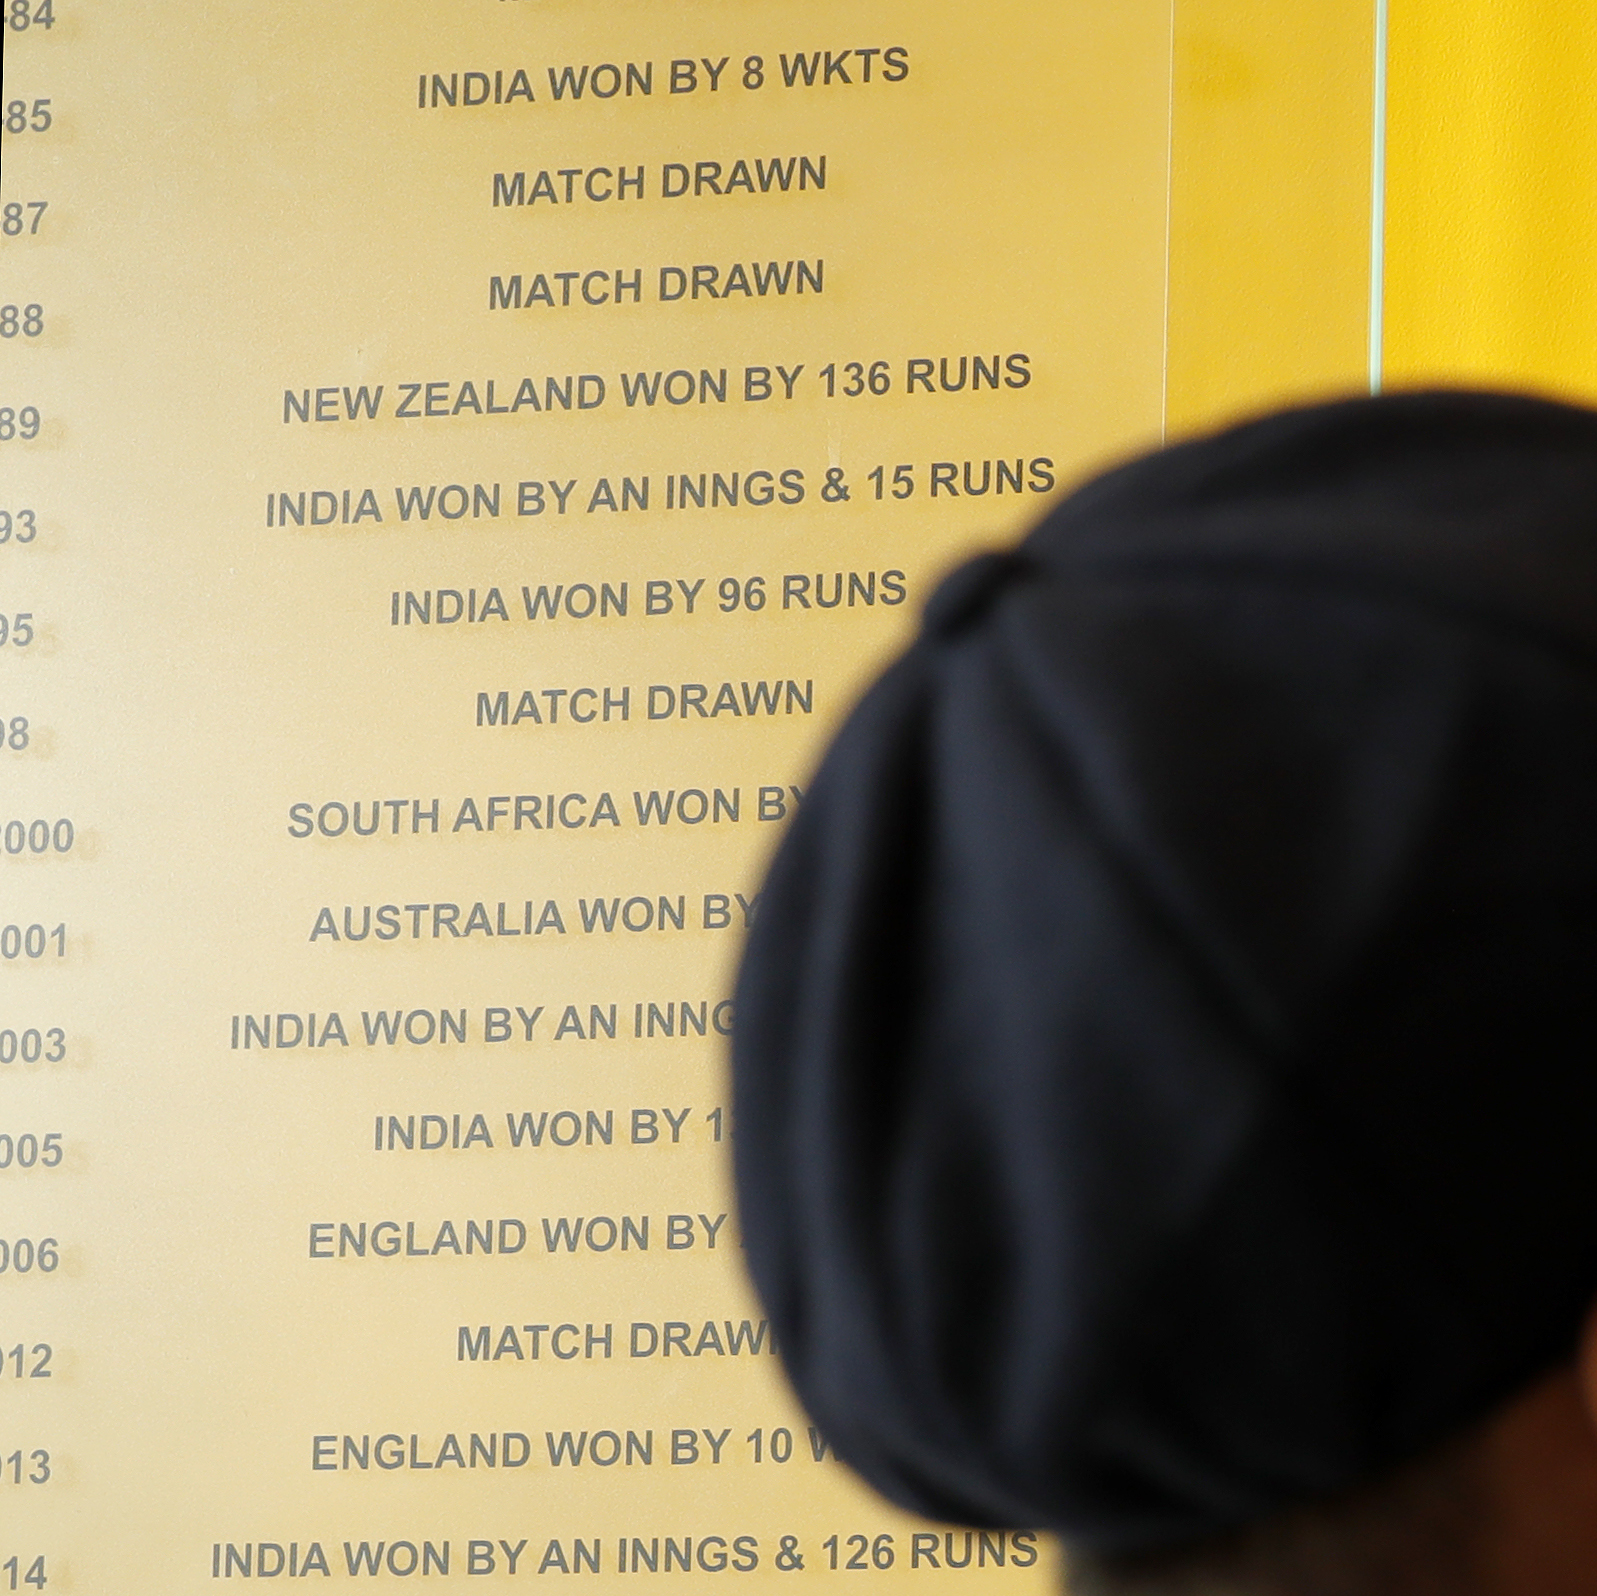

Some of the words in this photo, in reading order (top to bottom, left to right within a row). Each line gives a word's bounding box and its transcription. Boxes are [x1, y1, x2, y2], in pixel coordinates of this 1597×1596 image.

[418, 69, 536, 109] INDIA
[547, 61, 653, 101] WON
[669, 56, 731, 95] BY
[742, 55, 765, 91] 8
[778, 46, 910, 88] WKTS
[492, 165, 645, 208] MATCH
[661, 154, 827, 199] DRAWN
[489, 268, 642, 311] MATCH
[658, 258, 824, 302] DRAWN
[283, 385, 384, 424] NEW
[394, 374, 606, 418] ZEALAND
[620, 368, 727, 408] WON
[744, 364, 805, 402] BY
[819, 360, 891, 398] 136
[906, 352, 1032, 394] RUNS
[266, 488, 383, 528] INDIA
[394, 483, 501, 522] WON
[517, 479, 578, 517] BY
[586, 476, 650, 514] AN
[666, 468, 805, 510] INNGS
[820, 467, 851, 503] &
[867, 464, 915, 501] 15
[930, 457, 1055, 498] RUNS
[391, 587, 510, 626] INDIA
[521, 581, 629, 621] WON
[645, 578, 706, 616] BY
[718, 576, 767, 613] 96
[782, 569, 907, 610] RUNS
[476, 686, 630, 727] MATCH
[647, 679, 813, 720] DRAWN
[312, 1432, 531, 1471] ENGLAND
[545, 1429, 653, 1467] WON
[670, 1428, 733, 1465] BY
[746, 1427, 793, 1464] 10
[212, 1542, 331, 1578] INDIA
[343, 1540, 450, 1577] WON
[467, 1539, 529, 1576] BY
[537, 1538, 601, 1575] AN
[618, 1535, 759, 1574] INNGS
[774, 1534, 806, 1572] &
[822, 1533, 895, 1571] 126
[910, 1530, 1039, 1570] RUNS
